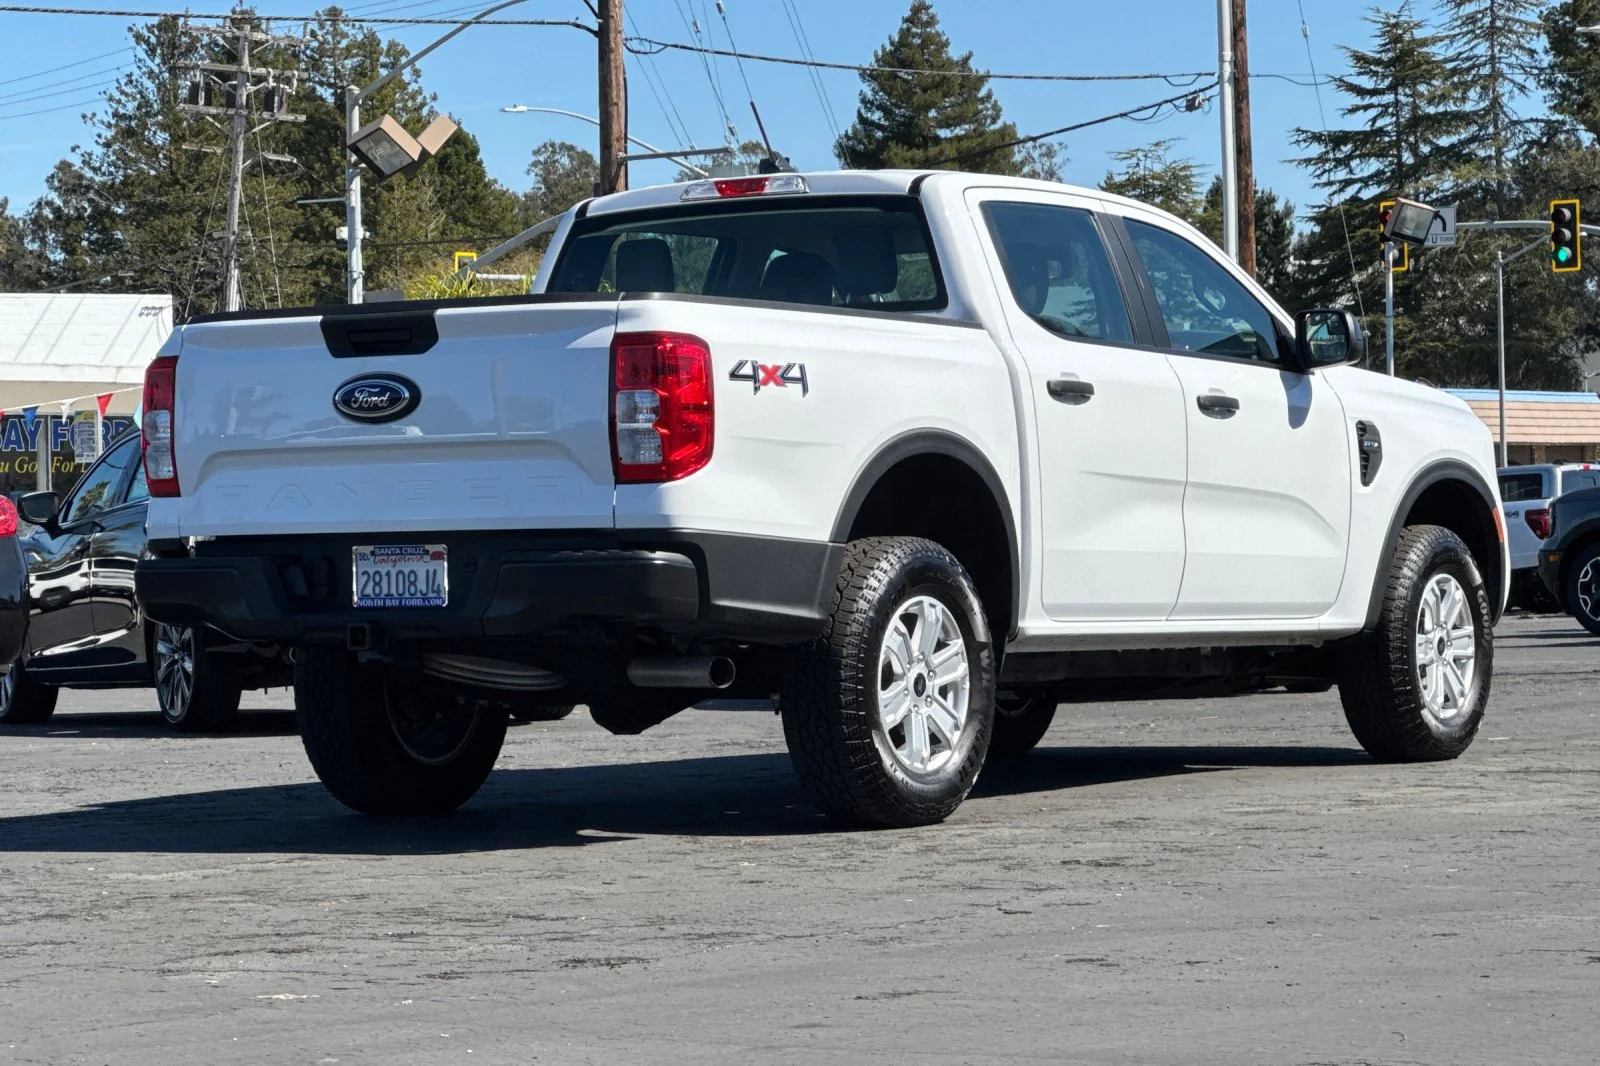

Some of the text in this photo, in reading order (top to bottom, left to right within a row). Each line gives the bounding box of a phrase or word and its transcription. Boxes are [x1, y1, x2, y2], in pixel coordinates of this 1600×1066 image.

[1431, 236, 1438, 244] U
[351, 387, 391, 408] Ford
[0, 419, 44, 452] AY
[51, 418, 131, 452] FR
[15, 456, 38, 474] Go
[52, 456, 75, 473] For
[374, 547, 401, 555] SANTA
[361, 568, 442, 597] 28108J4
[358, 598, 443, 607] NORTH BAY FORD.COM
